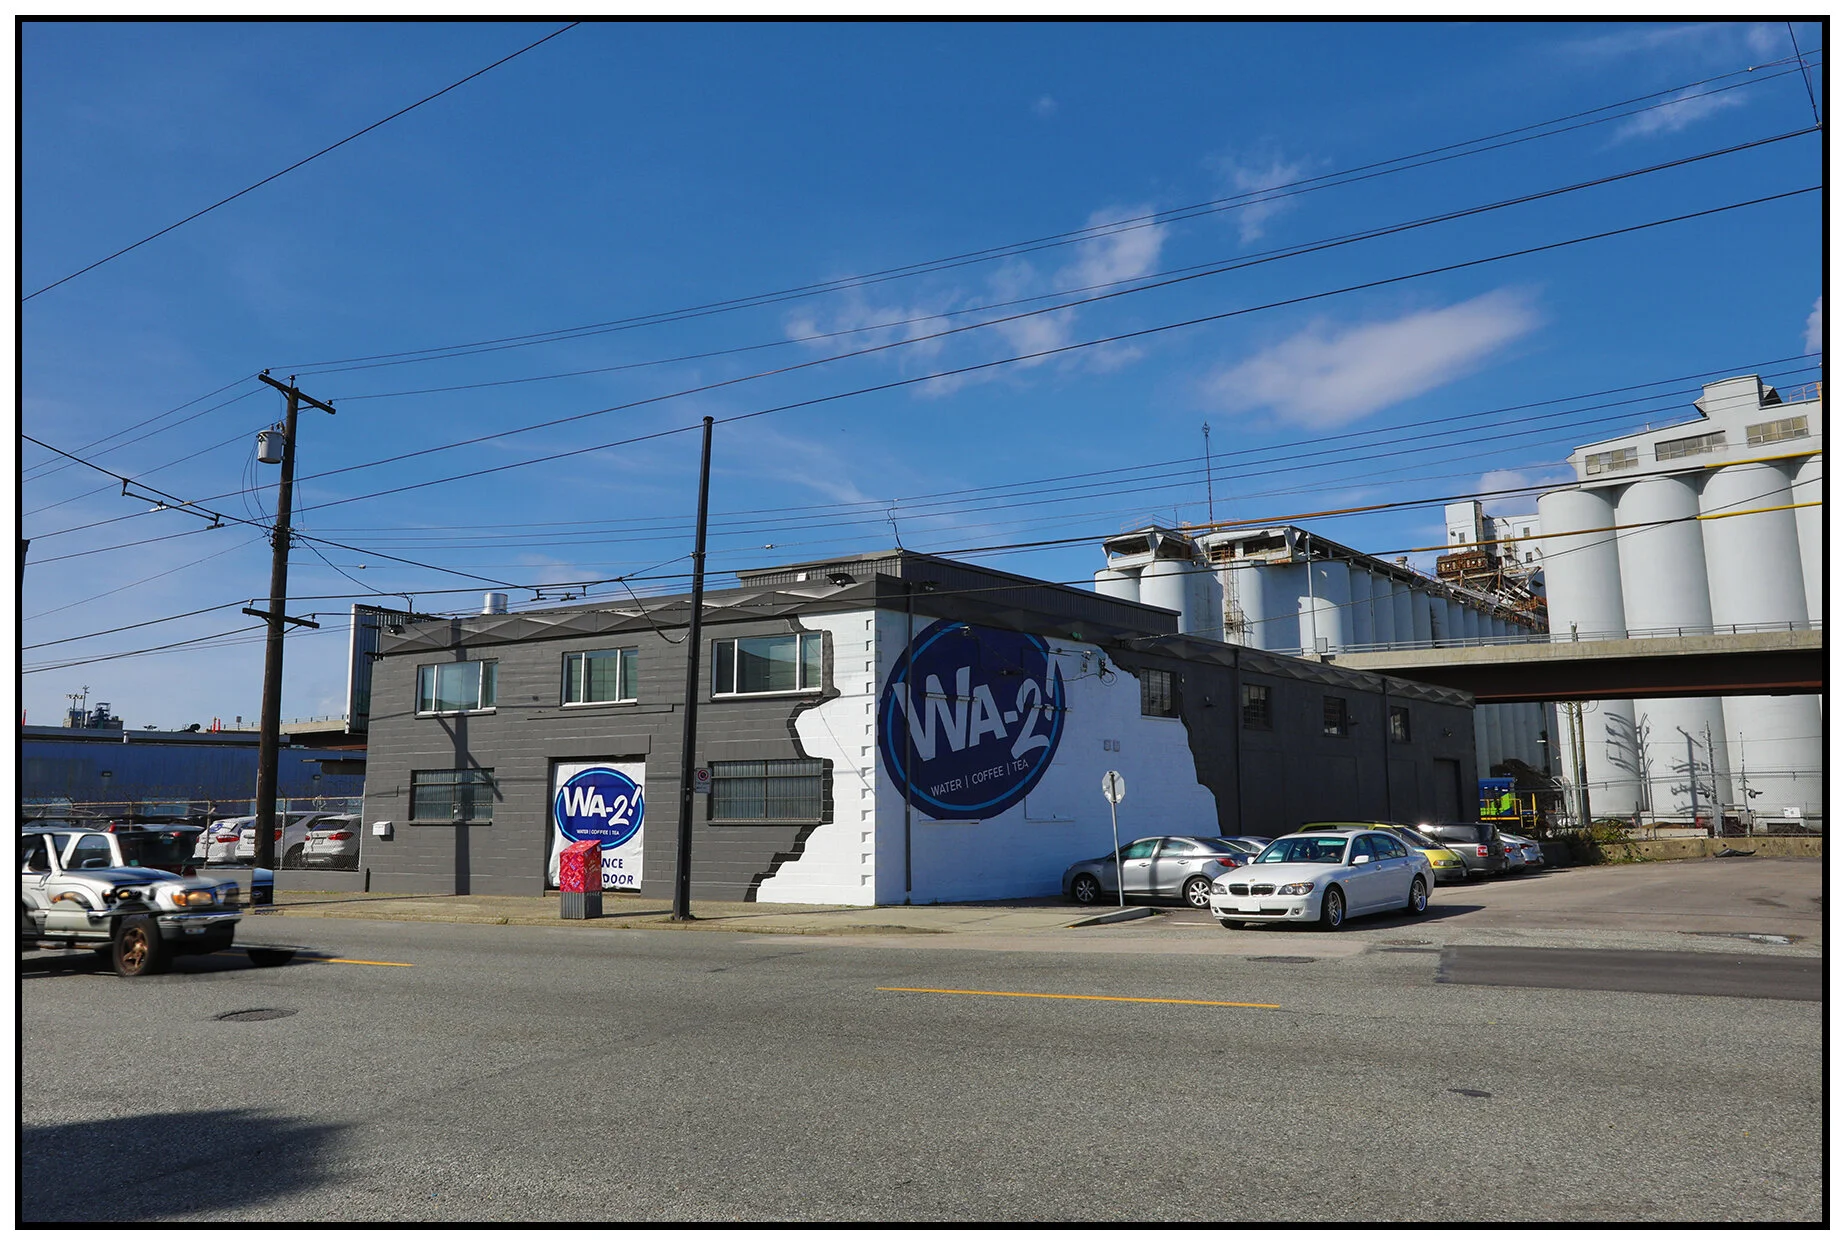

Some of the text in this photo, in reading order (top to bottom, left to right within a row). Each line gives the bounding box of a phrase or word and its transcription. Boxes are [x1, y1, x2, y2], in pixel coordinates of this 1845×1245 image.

[892, 649, 1057, 761] WA-2!
[930, 778, 962, 797] WATER
[971, 765, 1004, 784] COFFEE
[1012, 759, 1029, 772] TEA
[563, 786, 642, 826] WA-2!
[603, 873, 634, 885] DOOR
